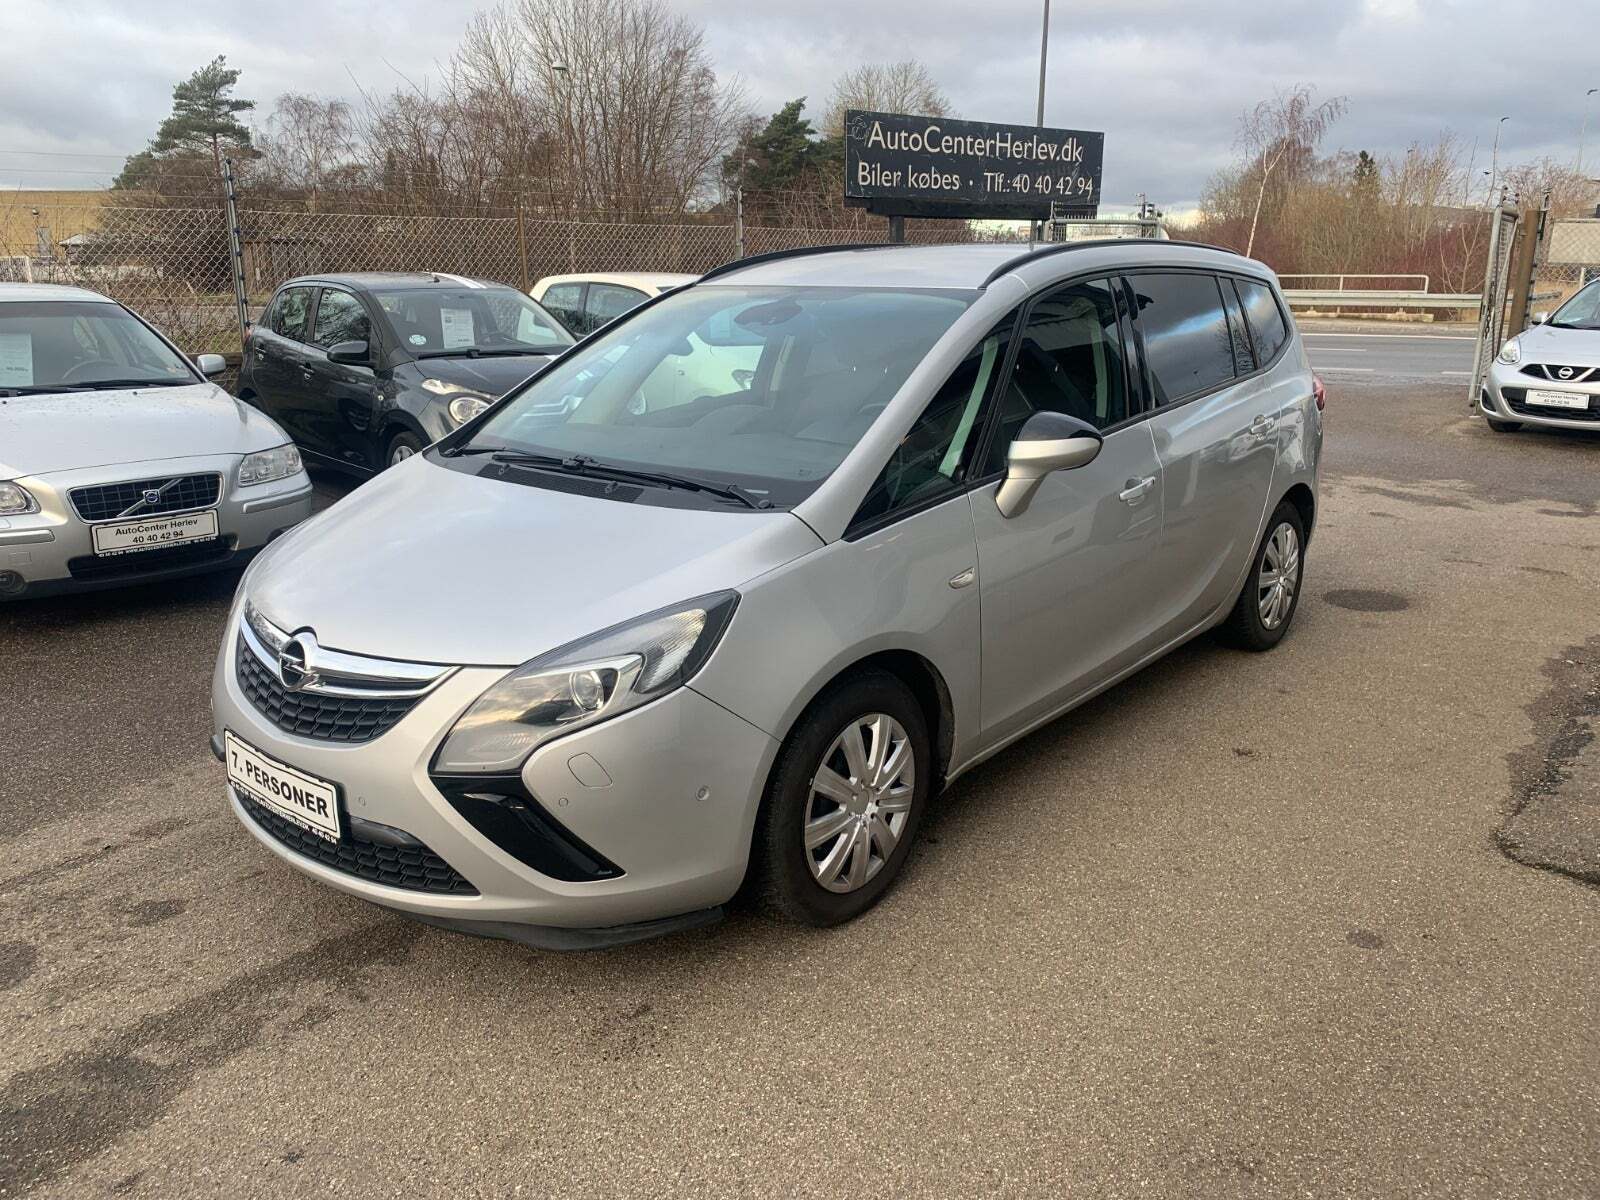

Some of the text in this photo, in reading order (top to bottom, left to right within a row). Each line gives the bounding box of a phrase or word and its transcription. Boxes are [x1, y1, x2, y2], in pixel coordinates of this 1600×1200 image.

[868, 121, 1083, 162] AutoCenterHerlev.dk
[858, 160, 901, 187] Biler
[908, 164, 960, 190] købes
[1034, 175, 1052, 194] 40
[1056, 176, 1073, 195] 42
[1077, 177, 1094, 200] 94
[115, 518, 198, 536] AutoCenter Herlev
[146, 534, 158, 542] 40
[160, 532, 171, 540] 42
[173, 530, 184, 538] 94
[231, 750, 243, 772] 7.
[245, 760, 329, 818] PERSONER
